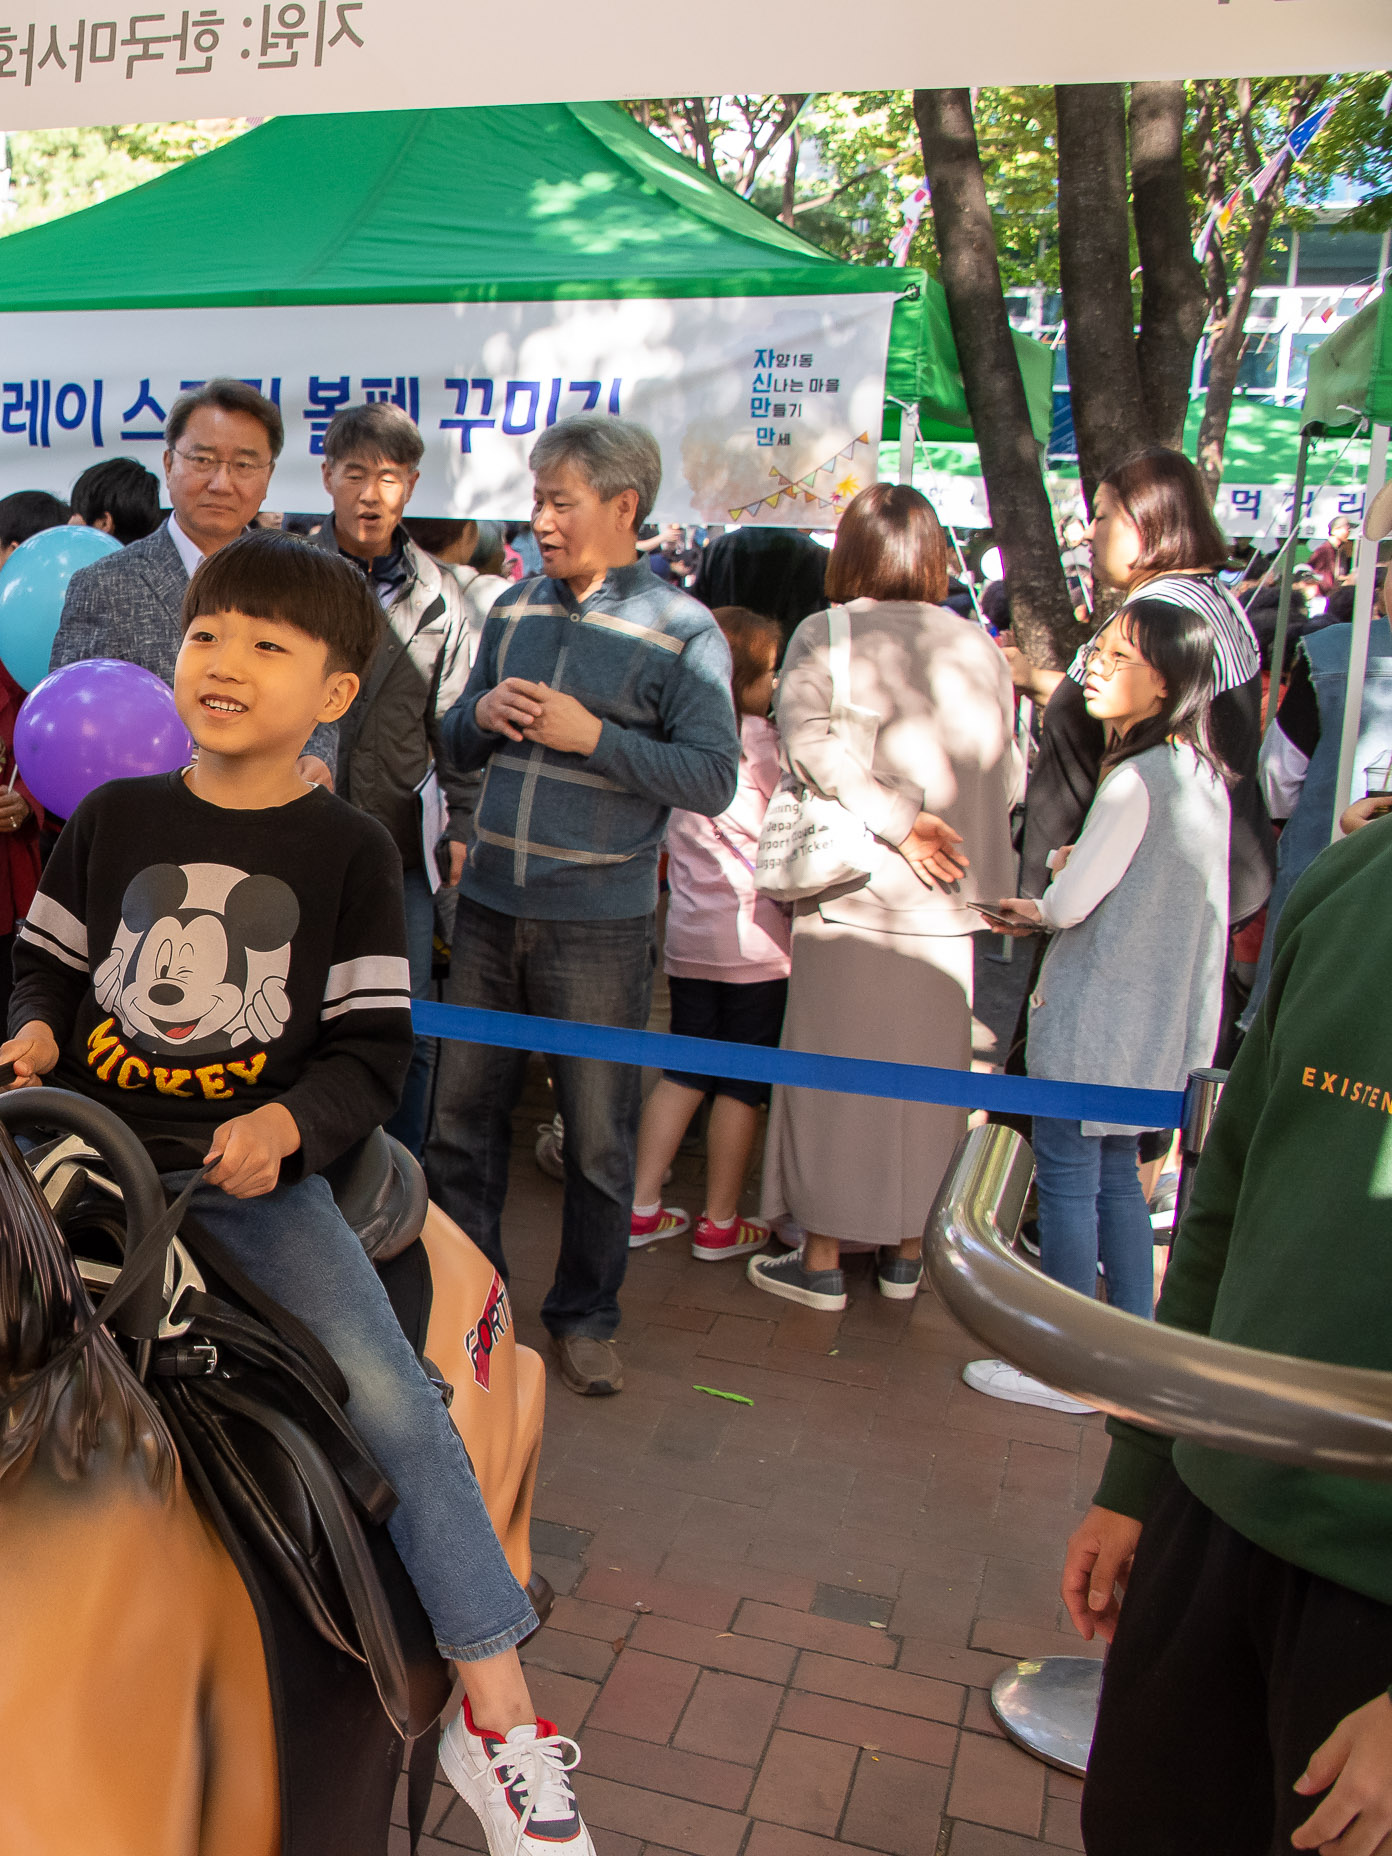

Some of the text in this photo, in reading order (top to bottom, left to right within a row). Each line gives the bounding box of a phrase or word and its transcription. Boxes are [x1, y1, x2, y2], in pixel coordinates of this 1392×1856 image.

[753, 349, 813, 368] 자양1동
[752, 373, 839, 393] 신나는 마을
[439, 377, 622, 454] 꾸미기
[751, 397, 802, 418] 만들기
[756, 427, 791, 446] 만세
[87, 1017, 268, 1101] MICKEY
